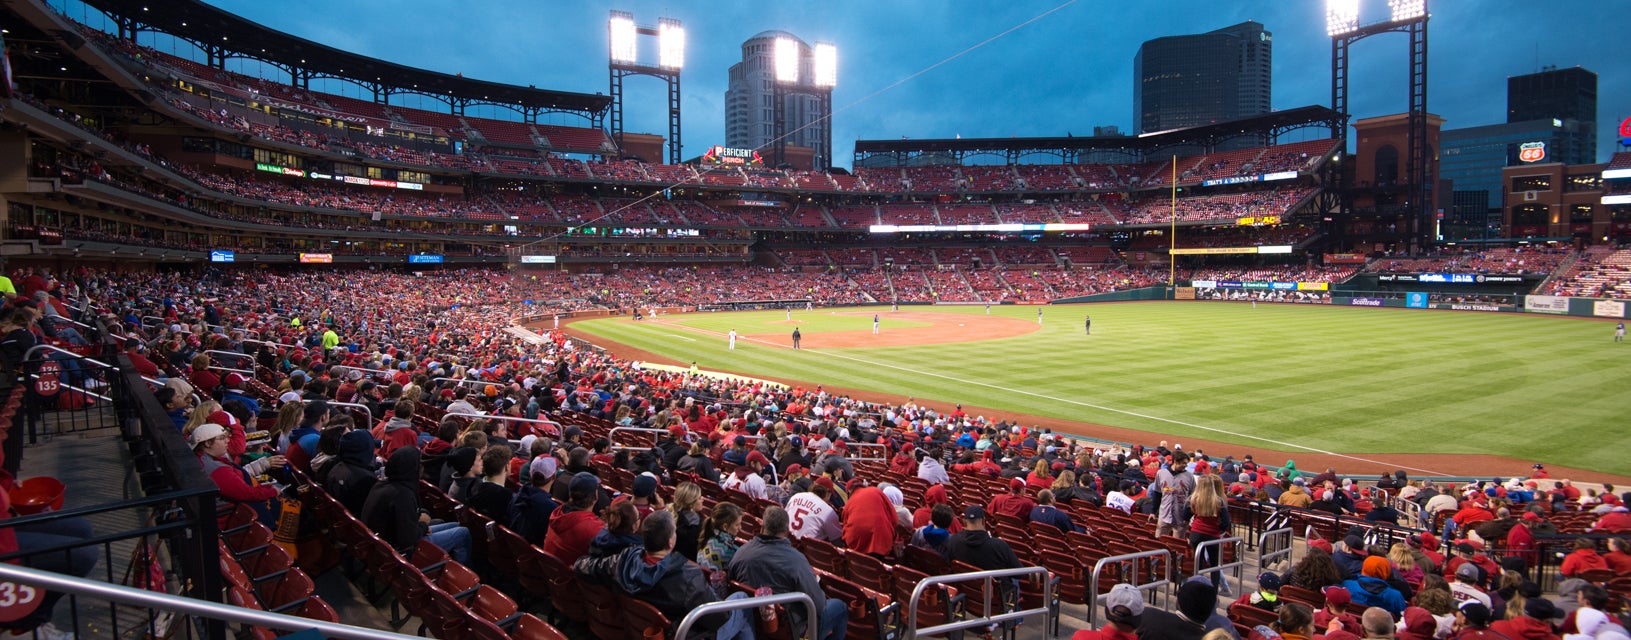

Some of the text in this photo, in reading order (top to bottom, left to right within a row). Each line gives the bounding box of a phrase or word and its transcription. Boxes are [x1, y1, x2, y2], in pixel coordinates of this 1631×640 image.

[714, 145, 752, 158] PERFICIENT
[1523, 149, 1541, 159] 66
[722, 156, 745, 164] PERCH
[1352, 298, 1380, 306] Scottrade
[38, 380, 57, 391] 135
[793, 497, 822, 515] PUJOLS
[791, 507, 809, 531] 5
